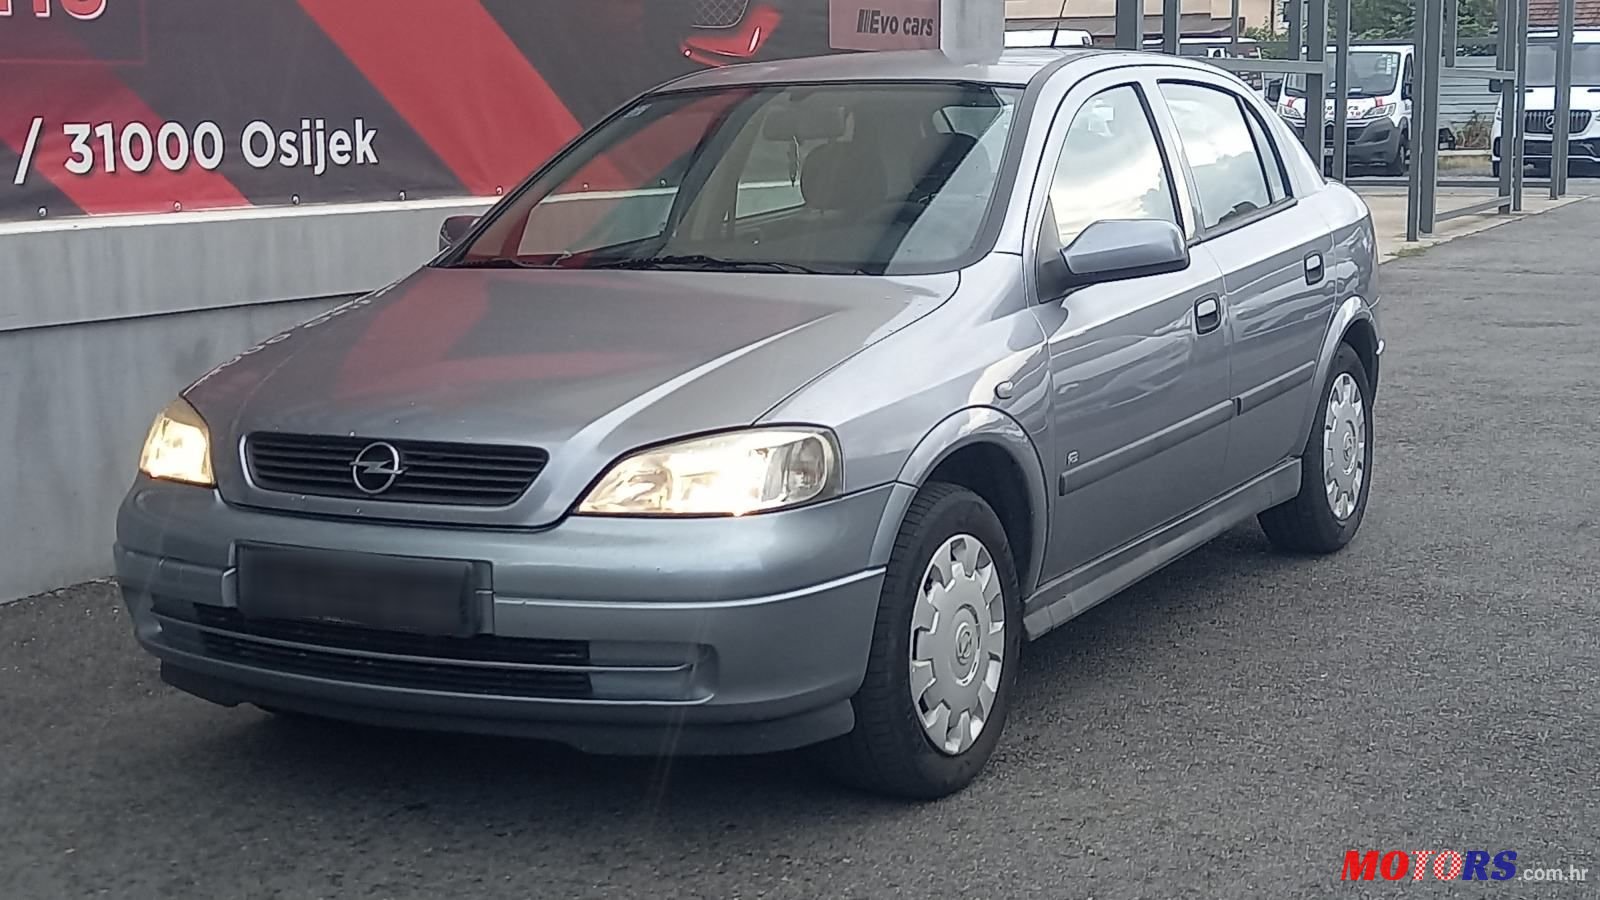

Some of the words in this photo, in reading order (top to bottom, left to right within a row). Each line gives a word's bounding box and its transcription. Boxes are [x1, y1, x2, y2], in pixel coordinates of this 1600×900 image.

[903, 17, 934, 36] cars
[13, 117, 43, 185] /
[63, 119, 225, 175] 31000
[241, 117, 379, 176] Osijek
